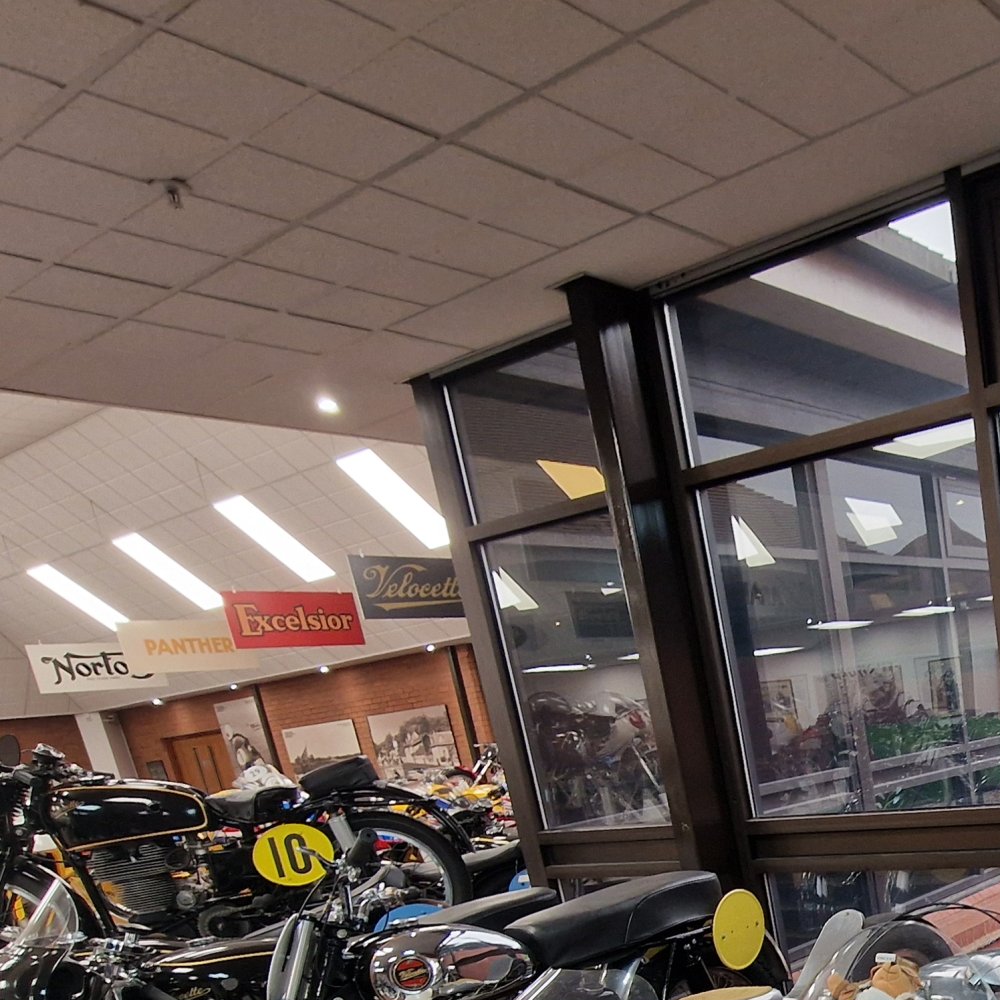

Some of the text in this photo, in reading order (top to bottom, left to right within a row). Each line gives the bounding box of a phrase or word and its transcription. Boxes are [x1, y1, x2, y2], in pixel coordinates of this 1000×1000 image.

[363, 564, 461, 599] Velocett
[233, 603, 353, 636] Excelsior
[144, 637, 235, 656] PANTHER
[41, 651, 154, 685] Norto
